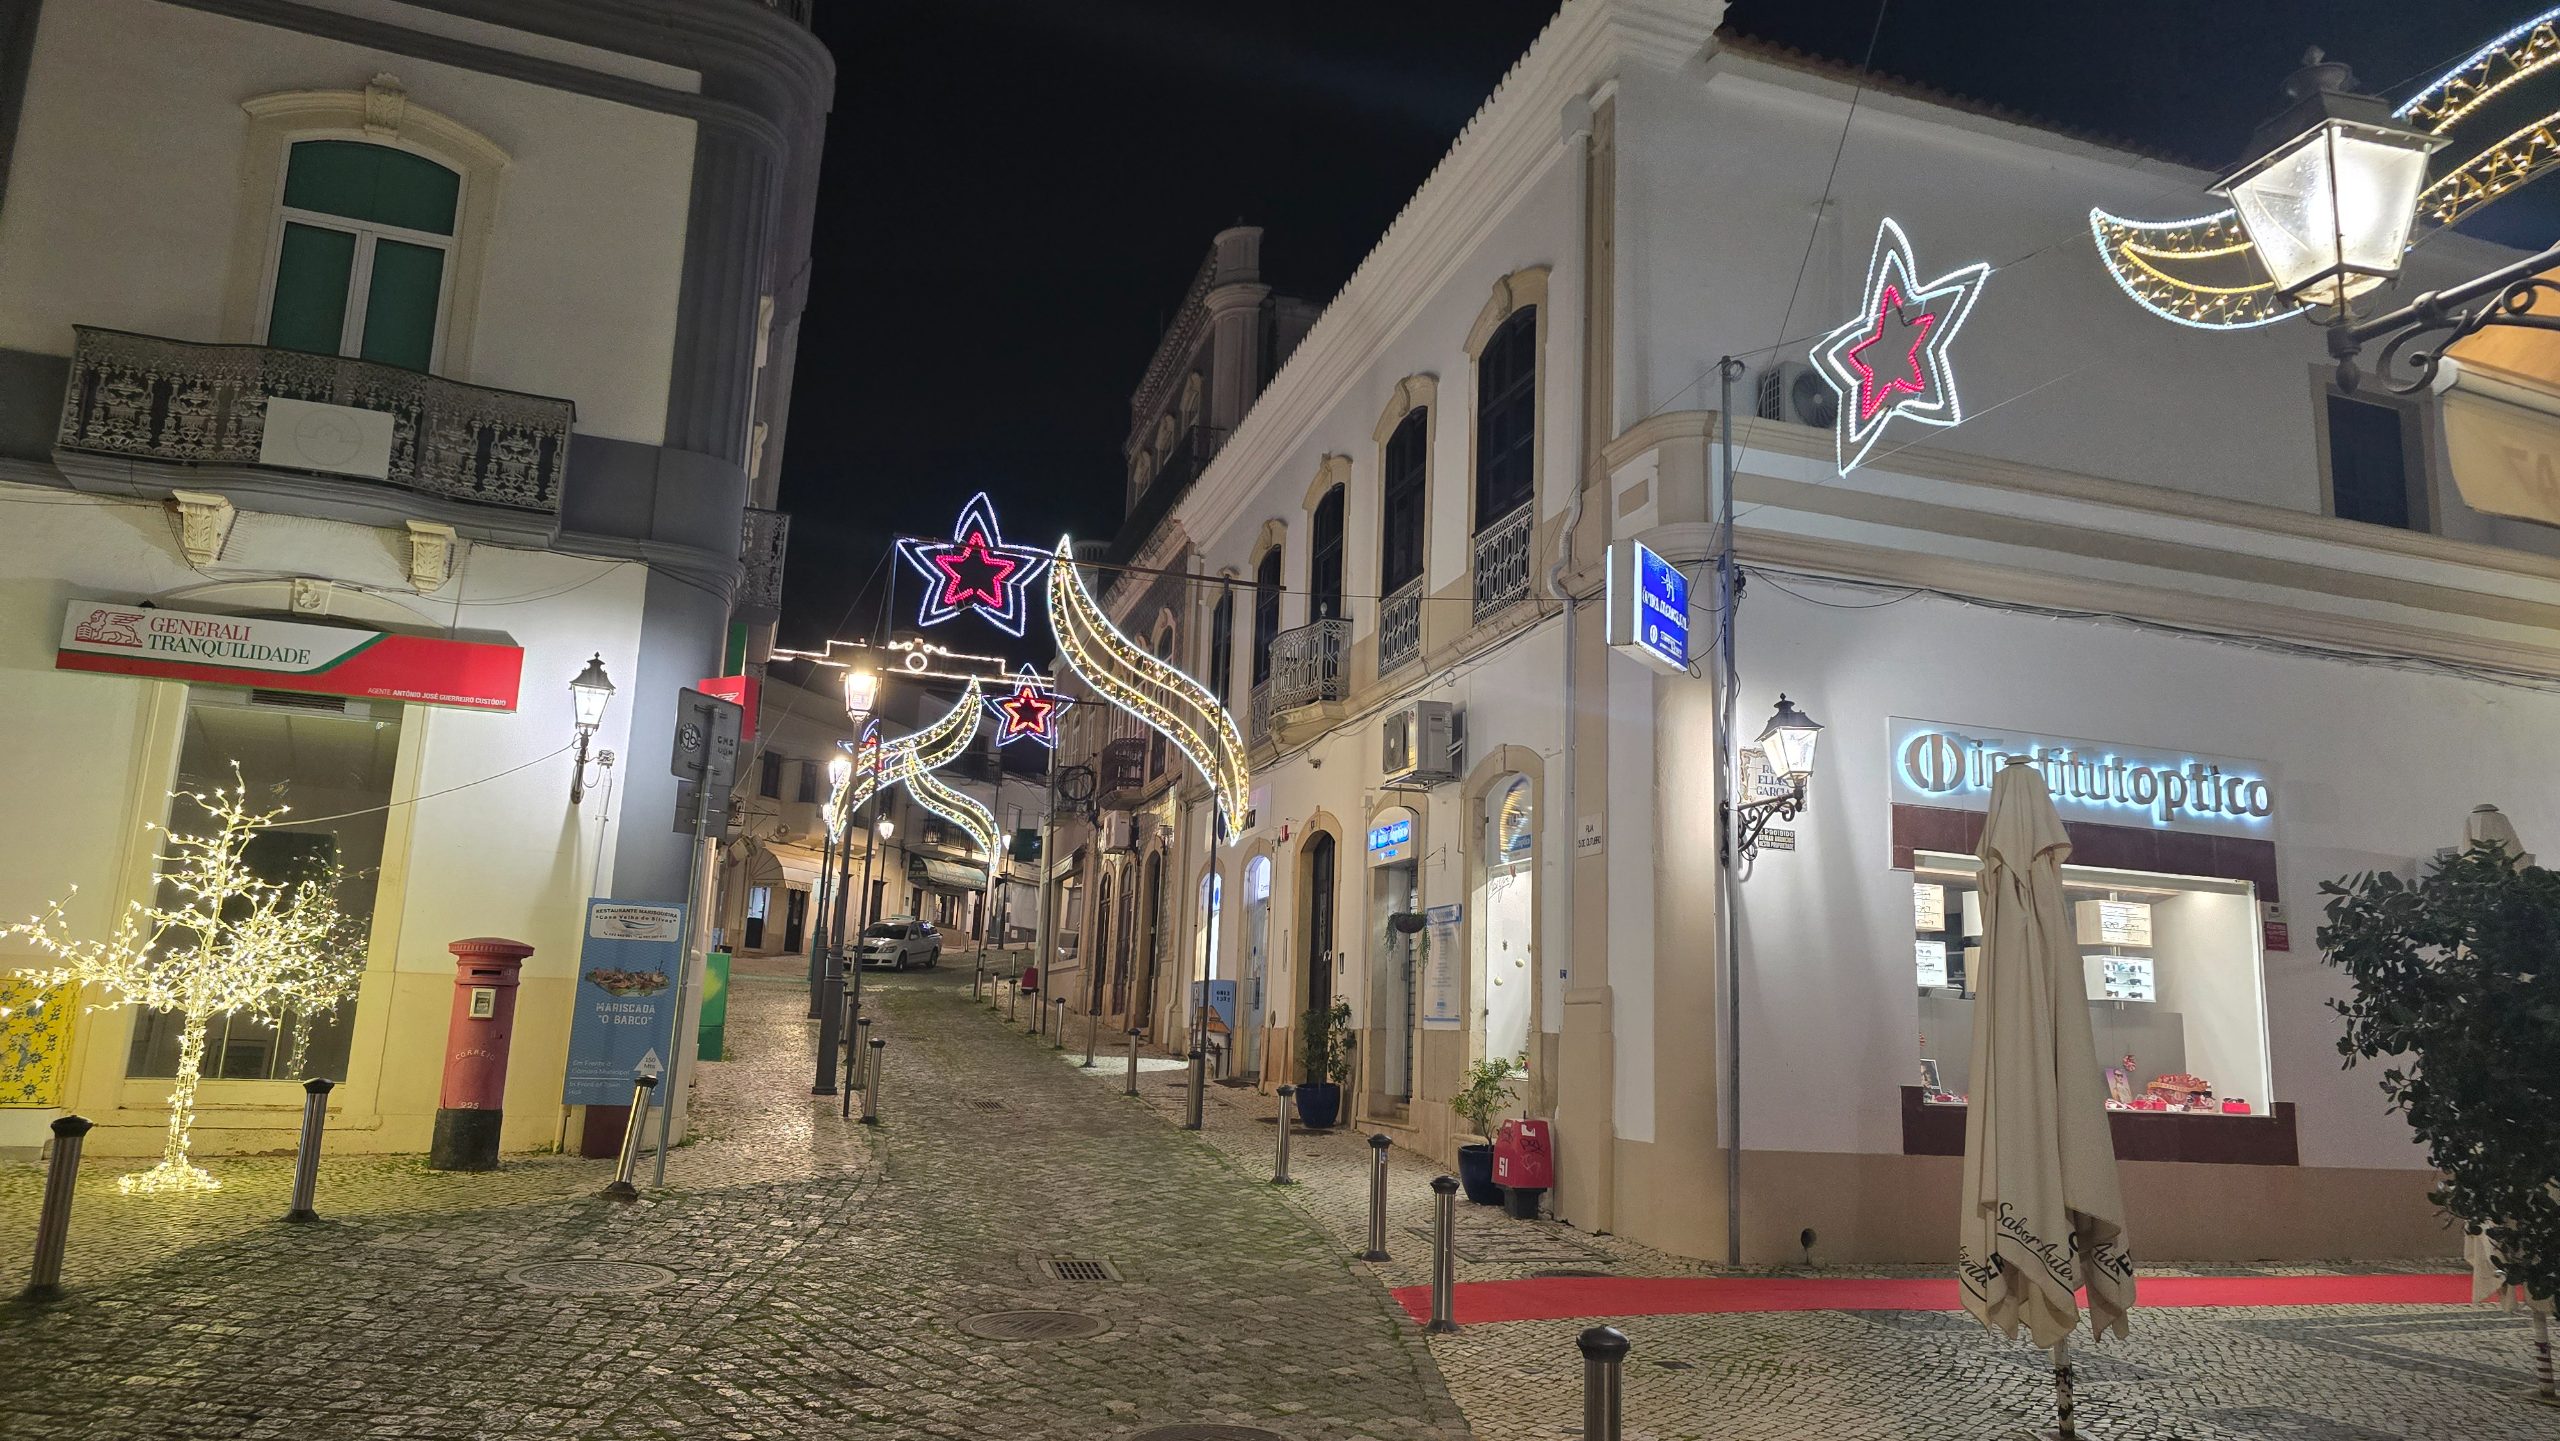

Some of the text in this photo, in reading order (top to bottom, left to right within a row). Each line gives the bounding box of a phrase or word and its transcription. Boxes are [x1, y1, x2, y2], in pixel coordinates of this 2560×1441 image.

[150, 617, 252, 641] GENERALI
[149, 634, 311, 664] TRANQUILIDADE
[392, 689, 421, 698] ANTÓNIO
[422, 691, 439, 700] JOSÉ
[439, 694, 475, 703] GUERREIRO
[475, 696, 507, 706] CUSTÓDIO
[1758, 775, 1787, 786] ELIAS
[1585, 824, 1594, 832] RUA
[596, 1002, 656, 1014] MARISCADA
[455, 1050, 496, 1062] CORREIO
[461, 1101, 480, 1110] 225
[1997, 1202, 2040, 1245] Sabor
